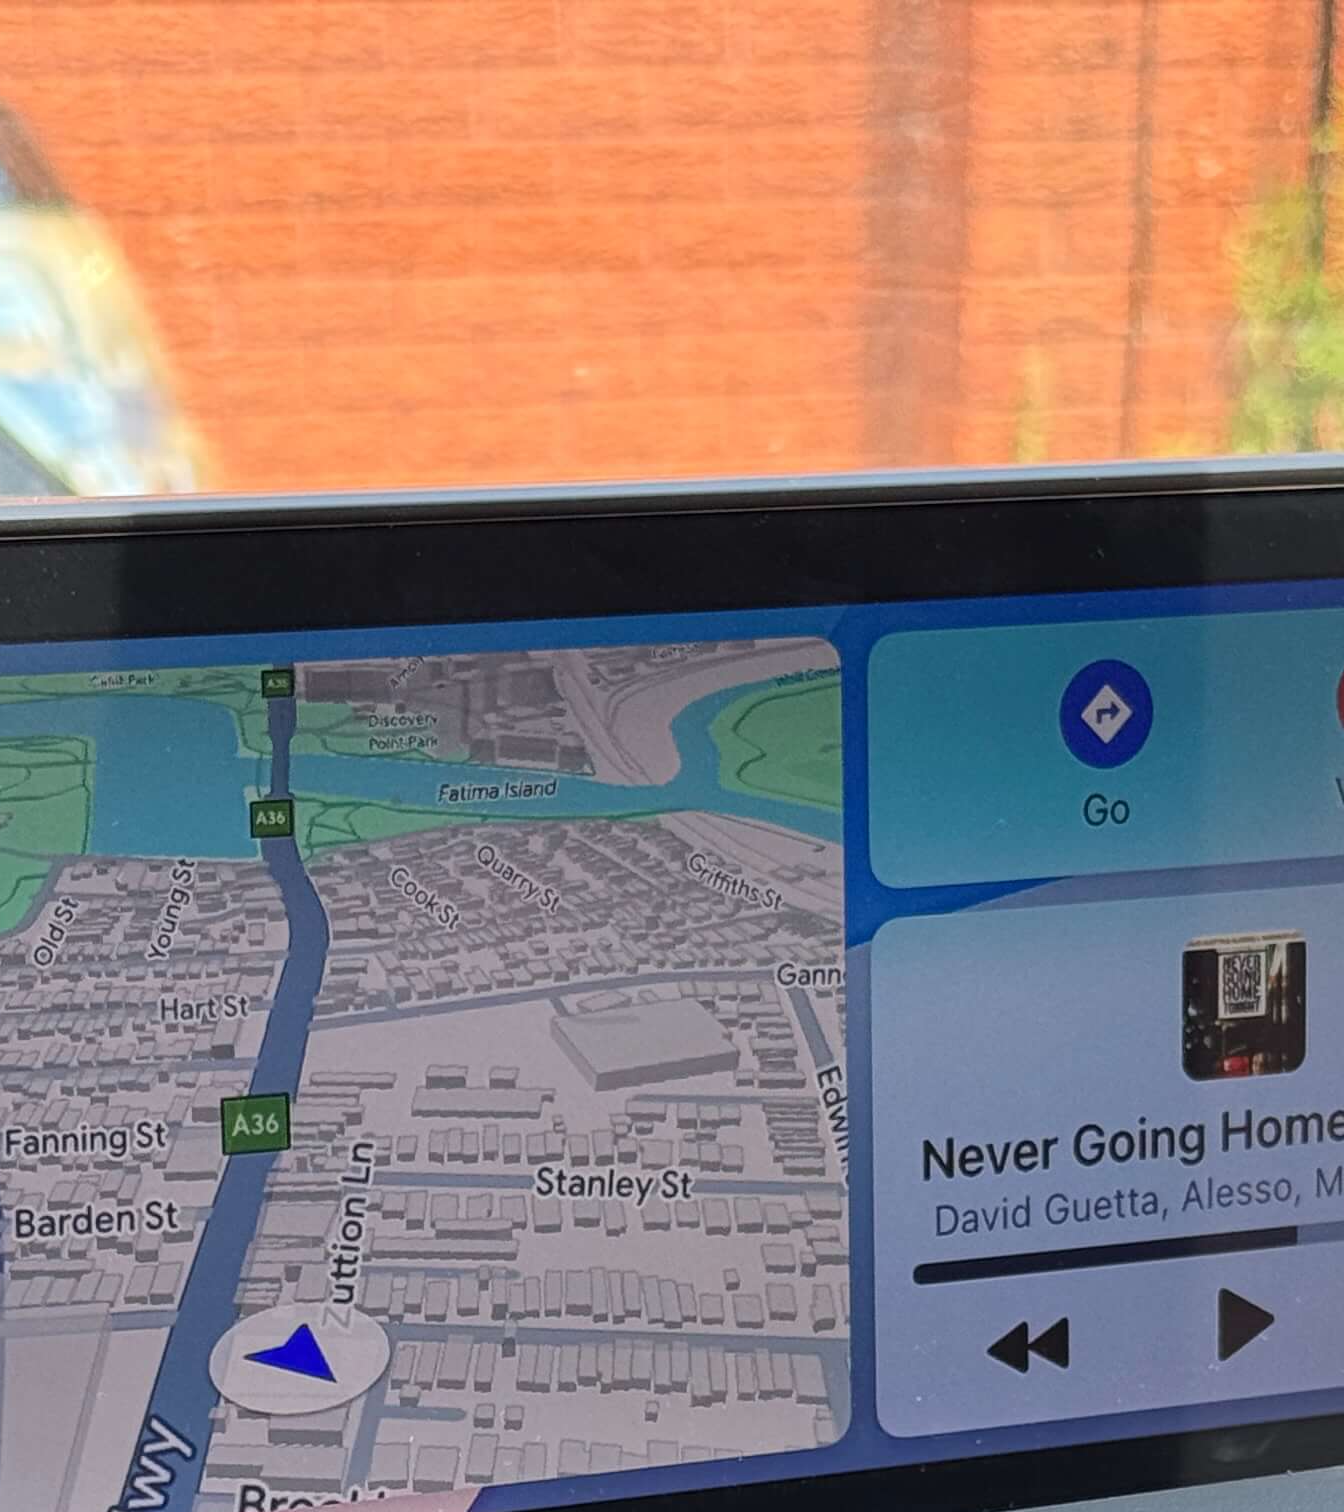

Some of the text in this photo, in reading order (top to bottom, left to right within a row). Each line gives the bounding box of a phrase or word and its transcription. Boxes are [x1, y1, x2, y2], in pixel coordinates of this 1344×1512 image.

[437, 780, 557, 802] Fatima Island
[1083, 793, 1130, 826] Go
[255, 810, 287, 826] A36
[390, 867, 460, 930] Cook St
[477, 845, 560, 914] Quarry St
[689, 853, 783, 911] Griffiths St
[147, 858, 195, 958] Young St
[33, 897, 80, 967] Old St
[160, 994, 249, 1021] Hart St
[5, 1121, 167, 1158] Fanning St
[231, 1112, 280, 1137] A36
[340, 1141, 375, 1185] Ln
[922, 1137, 1059, 1182] Never
[1072, 1116, 1206, 1166] Going
[536, 1166, 693, 1207] Stanley St
[935, 1194, 1032, 1237] David
[1044, 1187, 1170, 1225] Guetta,
[1181, 1176, 1301, 1213] Alesso,
[15, 1200, 179, 1239] Barden St
